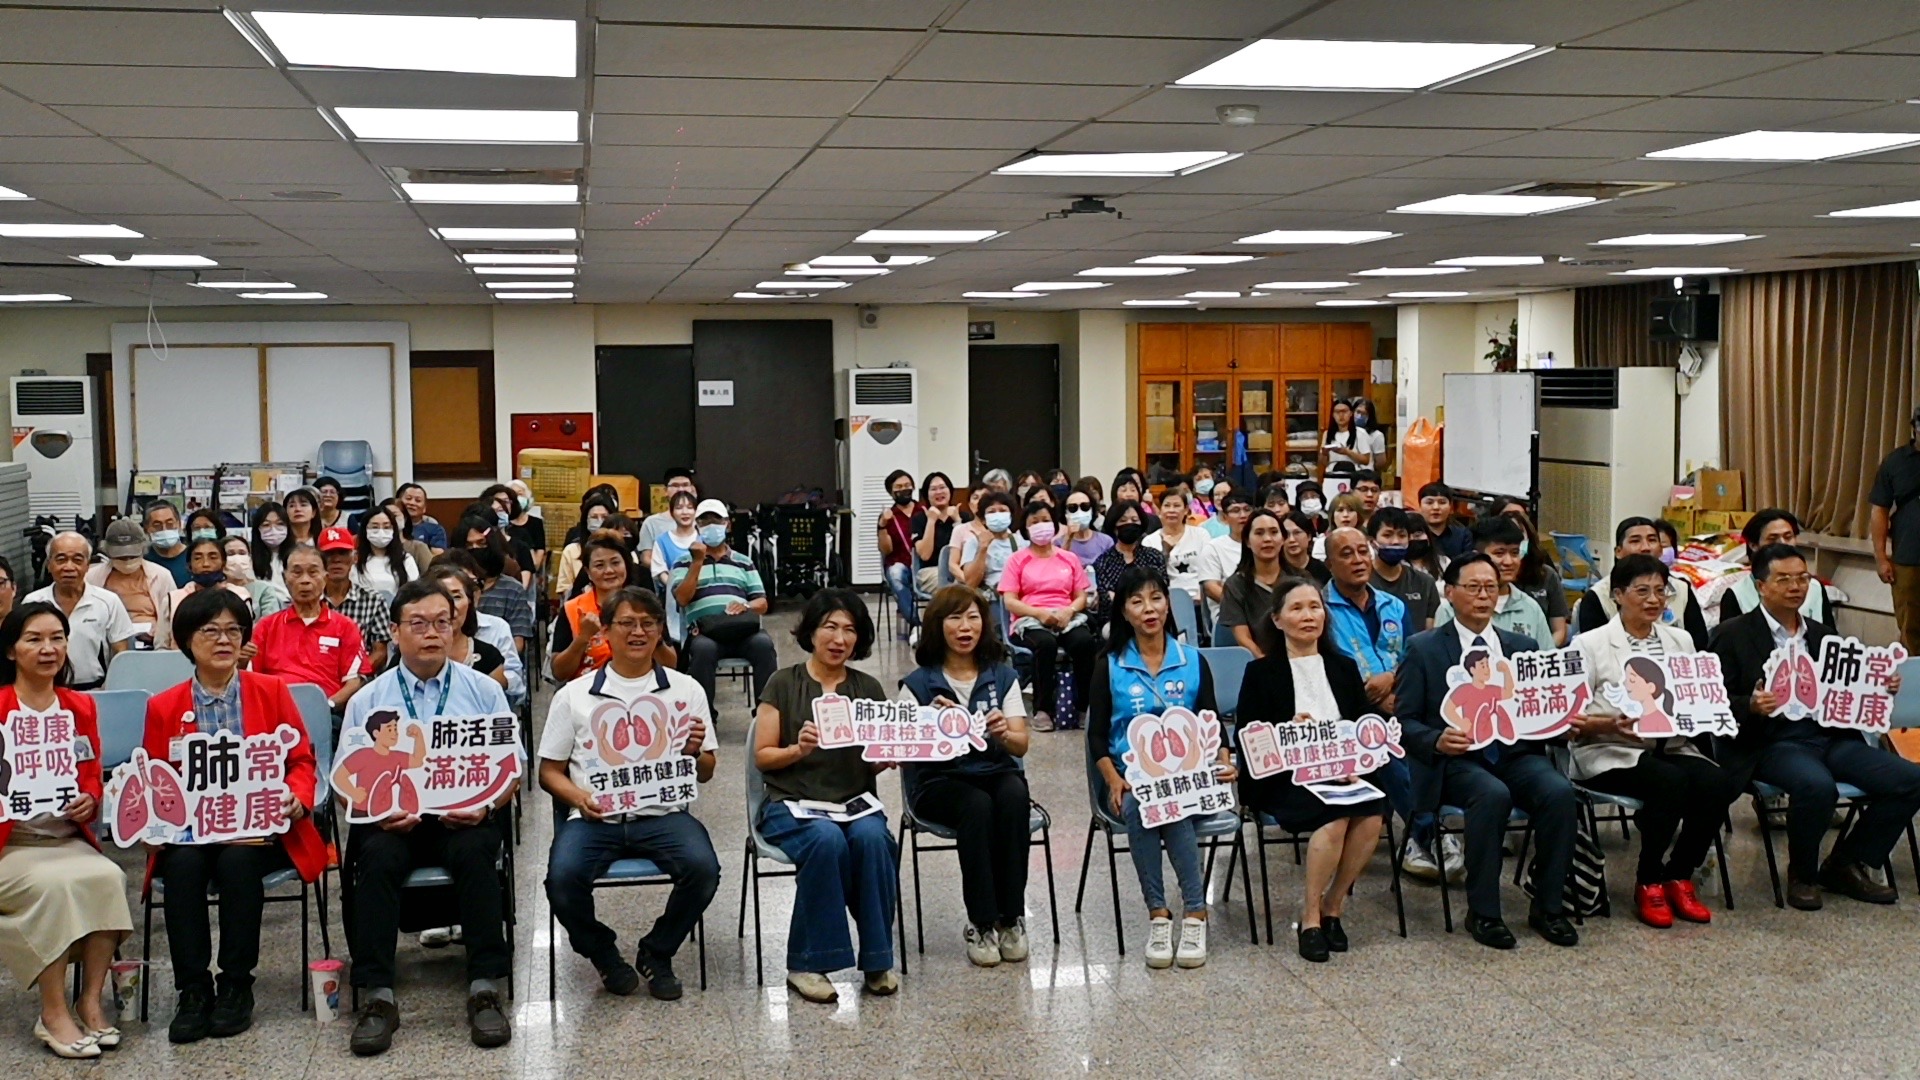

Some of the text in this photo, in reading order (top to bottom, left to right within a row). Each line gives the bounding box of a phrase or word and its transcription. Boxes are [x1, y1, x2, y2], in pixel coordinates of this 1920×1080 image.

[1516, 650, 1585, 682] 肺活量
[1667, 655, 1719, 680] 健康
[1820, 641, 1892, 686] 肺常
[1514, 683, 1568, 718] 滿滿
[1674, 683, 1726, 706] 呼吸
[1822, 687, 1889, 728] 健康
[855, 702, 918, 723] 肺功能
[1675, 712, 1735, 732] 每一天
[11, 713, 71, 747] 健康
[431, 717, 516, 749] 肺活量
[856, 723, 937, 742] 健康檢查
[1278, 719, 1338, 747] 肺功能
[15, 748, 74, 779] 呼吸
[186, 736, 281, 792] 肺常
[879, 745, 920, 758] 不能少
[1283, 738, 1358, 766] 健康檢查
[424, 753, 490, 790] 滿滿
[589, 758, 694, 791] 守護肺健康
[1307, 763, 1345, 778] 不能少
[9, 787, 76, 815] 每一天
[193, 788, 284, 838] 健康
[595, 783, 695, 814] 臺東一起來
[1142, 791, 1232, 825] 臺東一起來
